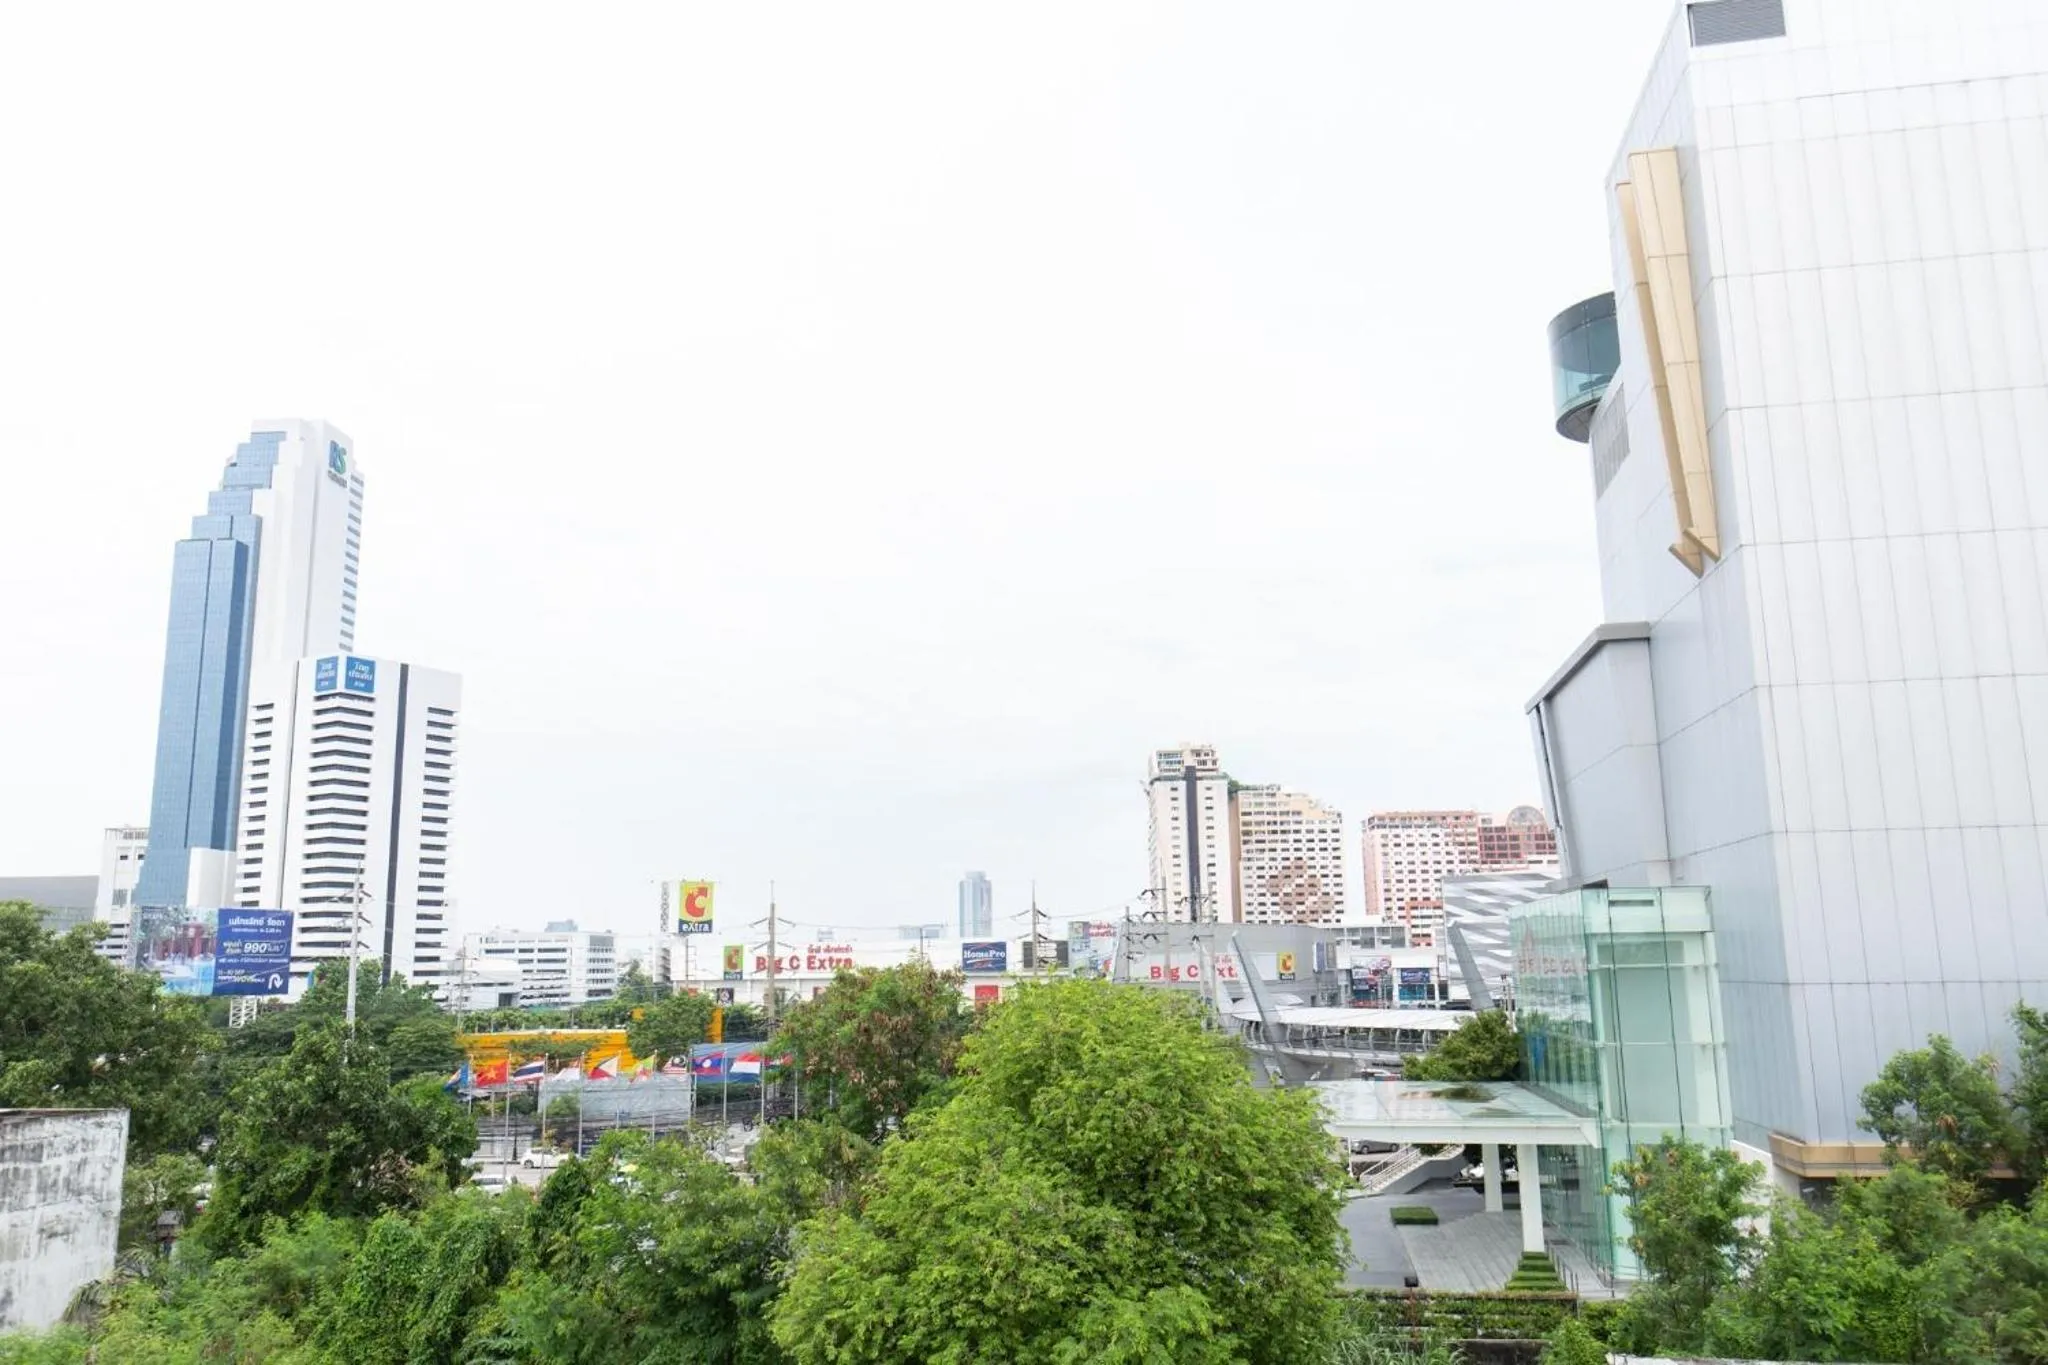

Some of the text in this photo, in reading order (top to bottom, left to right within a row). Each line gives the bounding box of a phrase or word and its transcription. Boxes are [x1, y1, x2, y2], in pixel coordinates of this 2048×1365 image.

[243, 942, 268, 954] 990
[756, 956, 783, 974] Bg
[789, 955, 801, 970] C
[1150, 965, 1180, 982] Bg
[1187, 964, 1199, 978] C
